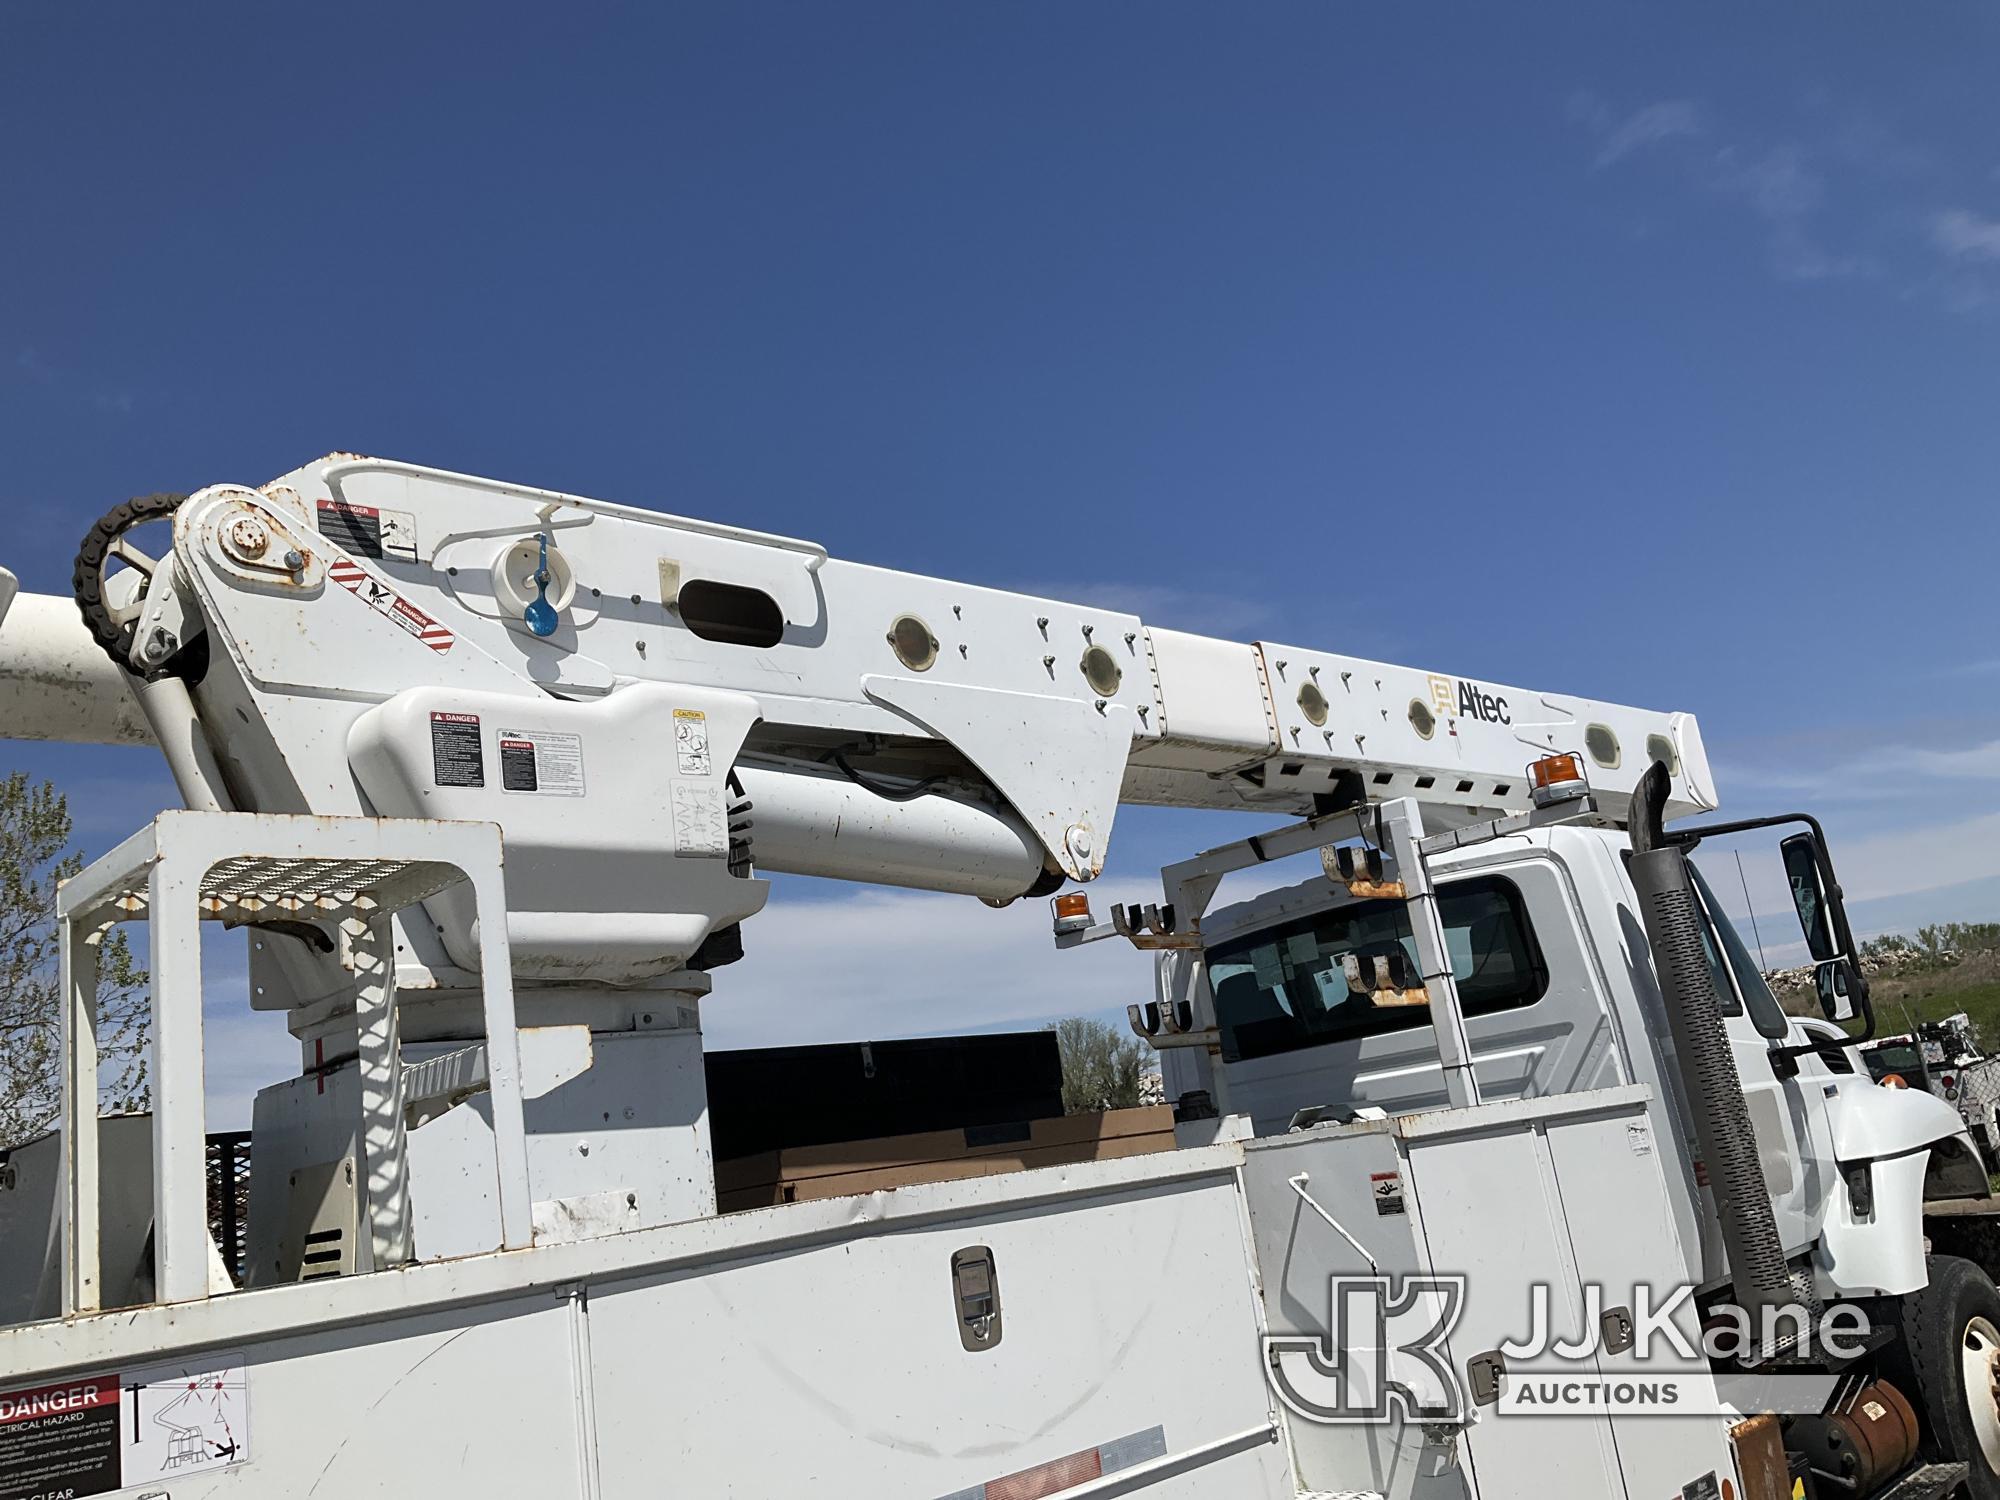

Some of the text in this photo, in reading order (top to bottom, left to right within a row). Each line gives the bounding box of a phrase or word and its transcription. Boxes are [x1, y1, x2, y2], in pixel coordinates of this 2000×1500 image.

[337, 504, 369, 514] DANGER
[402, 605, 427, 625] DANGER
[1458, 680, 1511, 725] Altec
[446, 714, 477, 723] DANGER
[0, 1385, 98, 1420] DANGER
[43, 1412, 85, 1427] HAZARD
